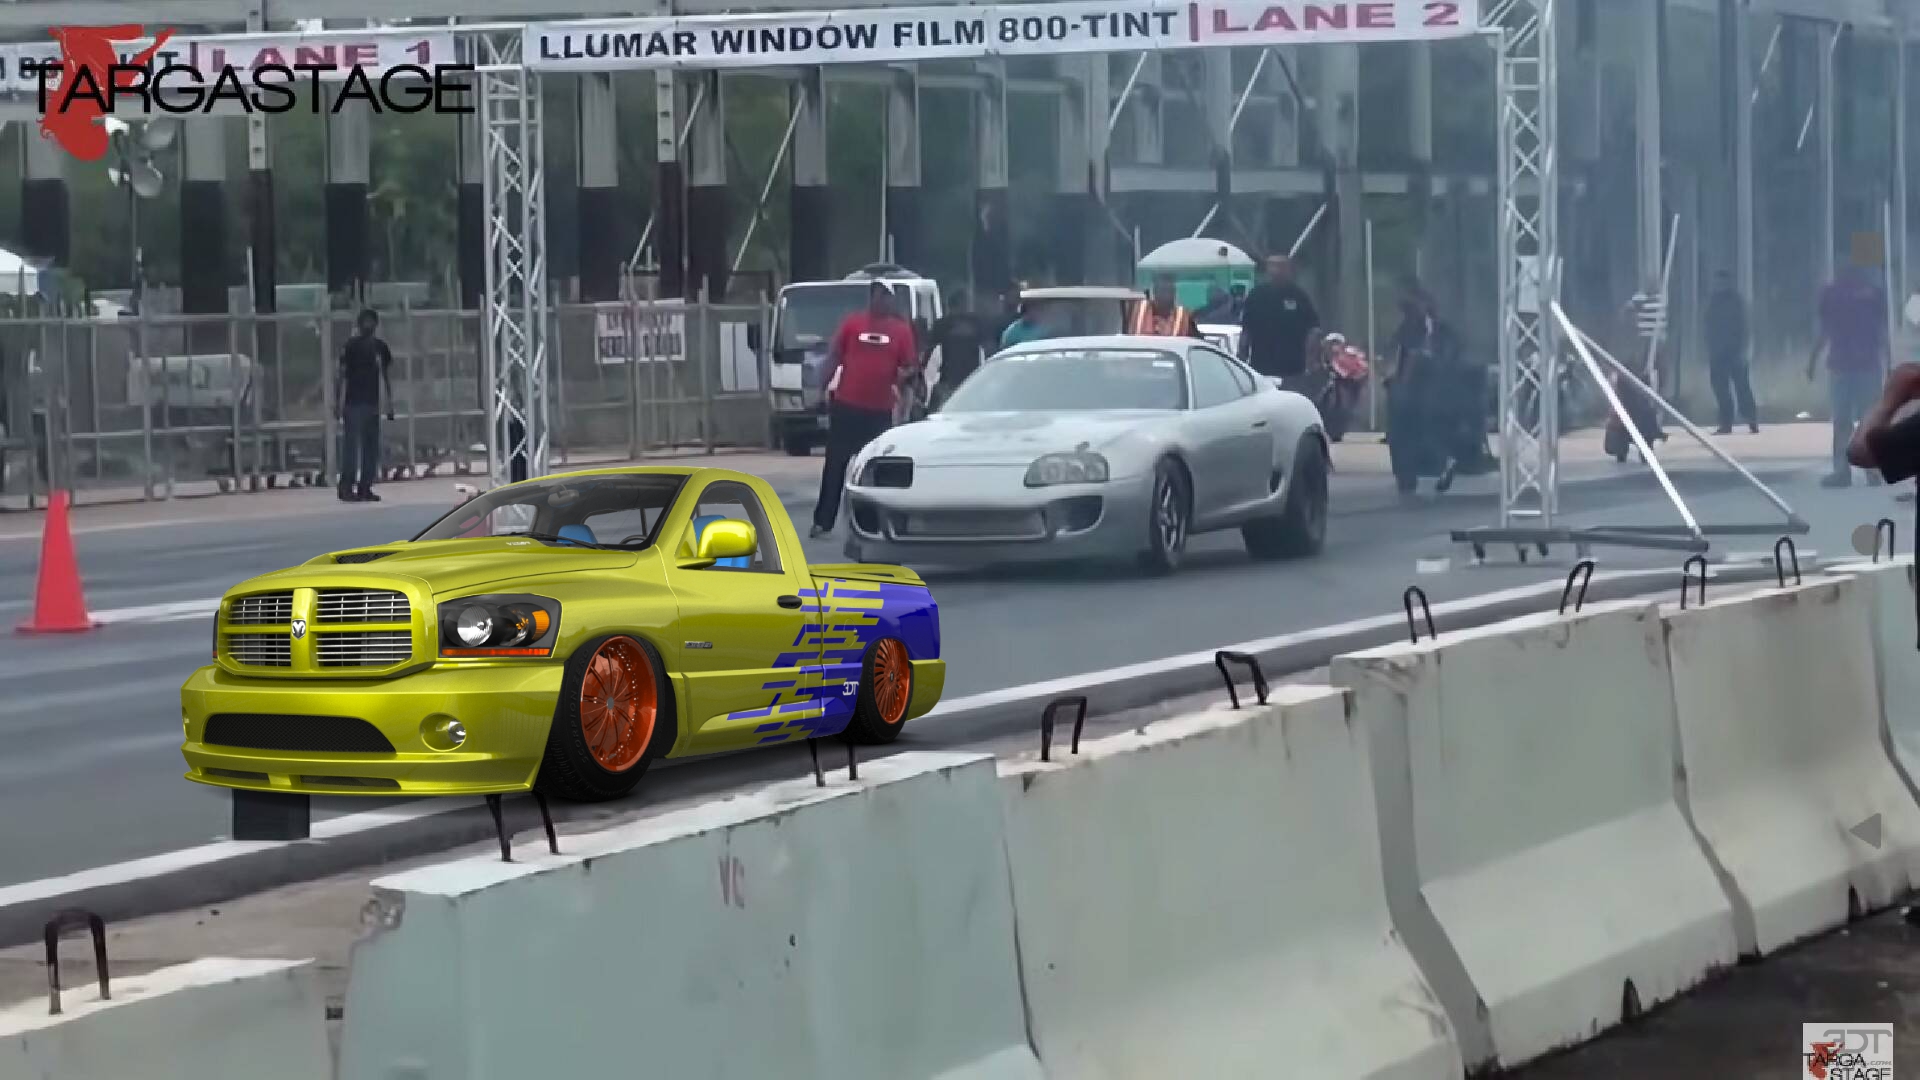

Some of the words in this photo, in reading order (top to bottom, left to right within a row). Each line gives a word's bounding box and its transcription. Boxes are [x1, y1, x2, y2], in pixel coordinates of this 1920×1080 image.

[539, 31, 697, 59] LLUMAR
[711, 23, 878, 55] WINDOW
[893, 20, 985, 48] FILM
[999, 12, 1178, 42] 800-TINT
[1212, 3, 1396, 33] LANE
[1422, 2, 1459, 28] 2
[212, 44, 380, 73] LANE
[405, 40, 430, 65] 1
